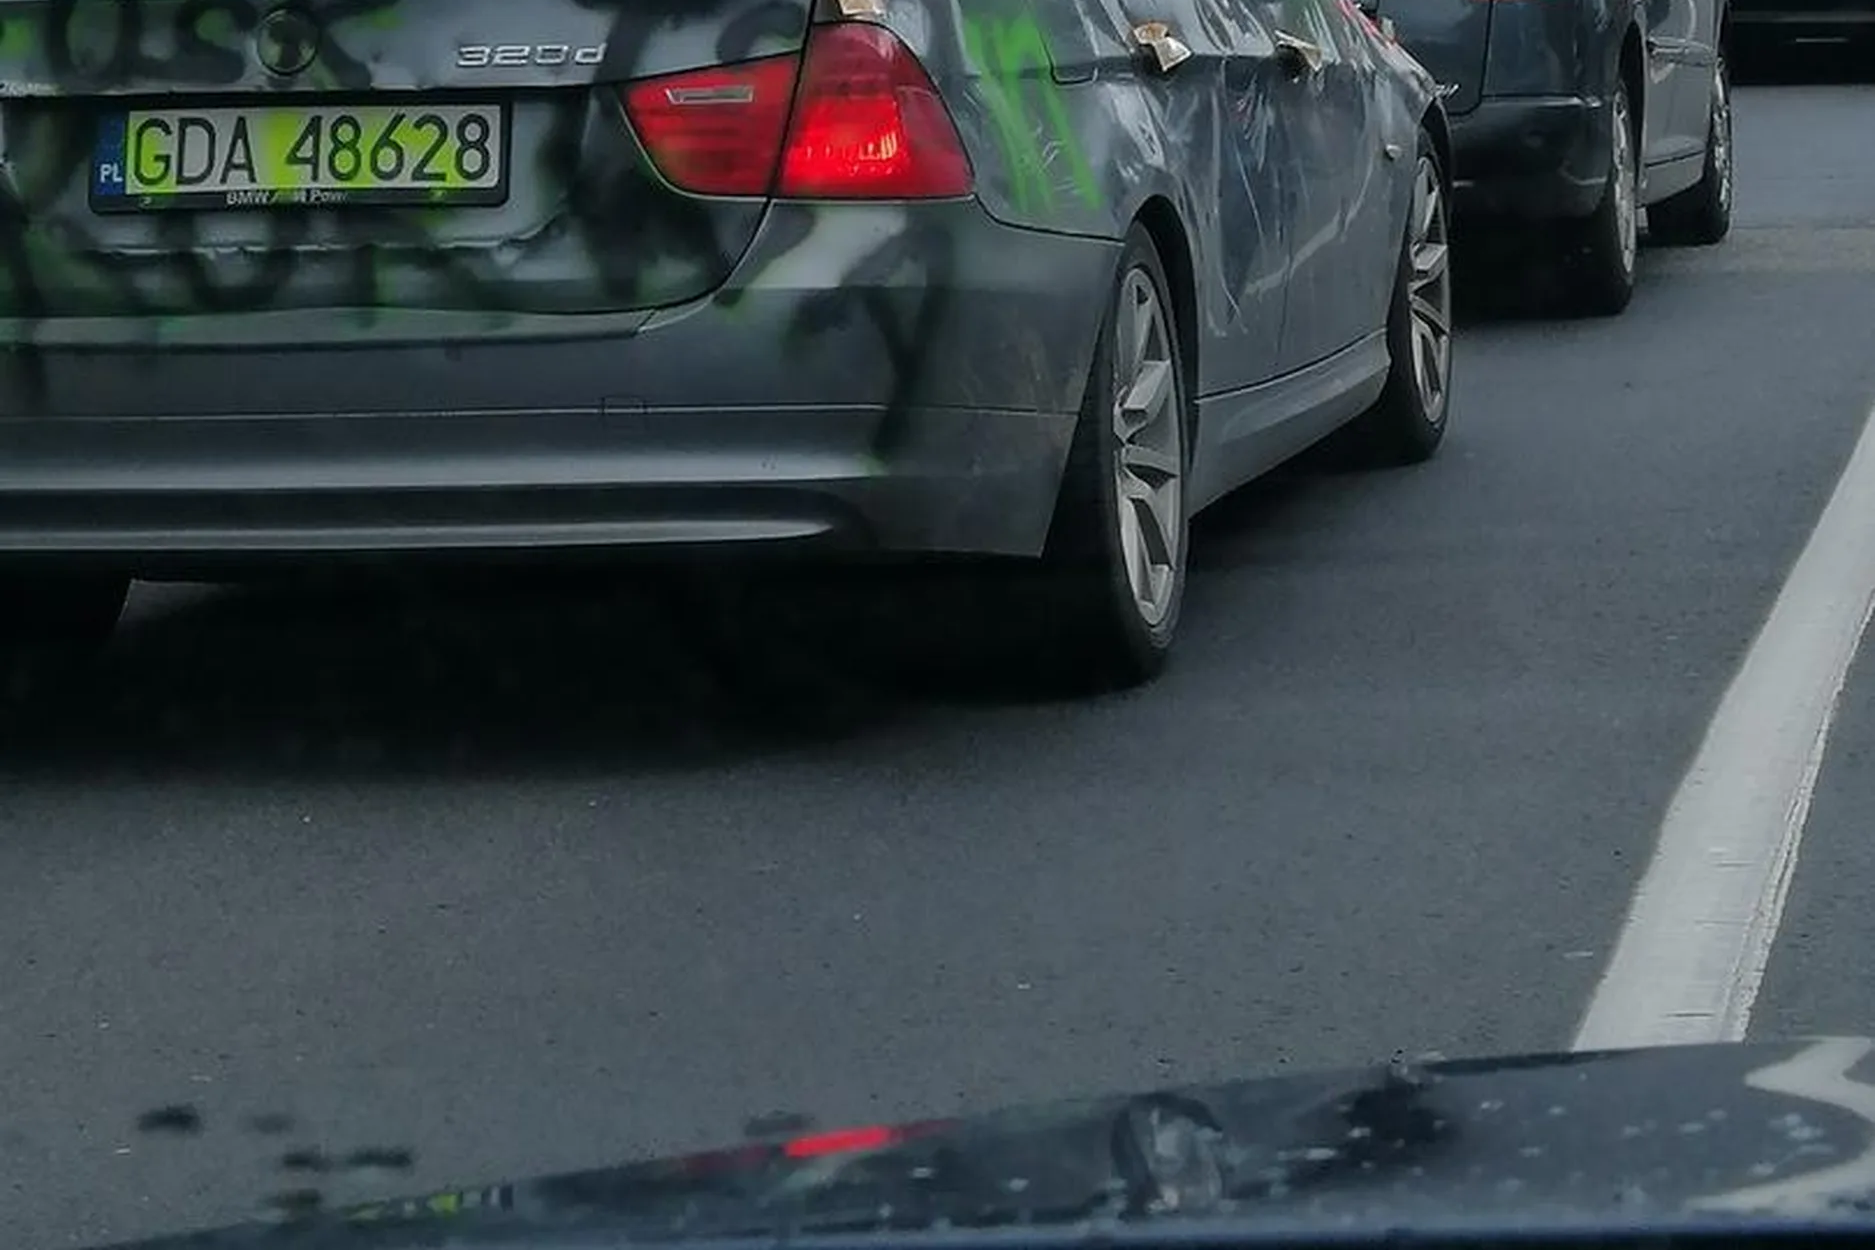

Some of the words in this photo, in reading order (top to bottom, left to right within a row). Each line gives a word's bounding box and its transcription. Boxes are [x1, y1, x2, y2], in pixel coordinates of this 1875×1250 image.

[457, 42, 608, 67] 320d
[132, 116, 258, 186] GDA
[283, 112, 492, 182] 48628
[100, 163, 123, 183] PL
